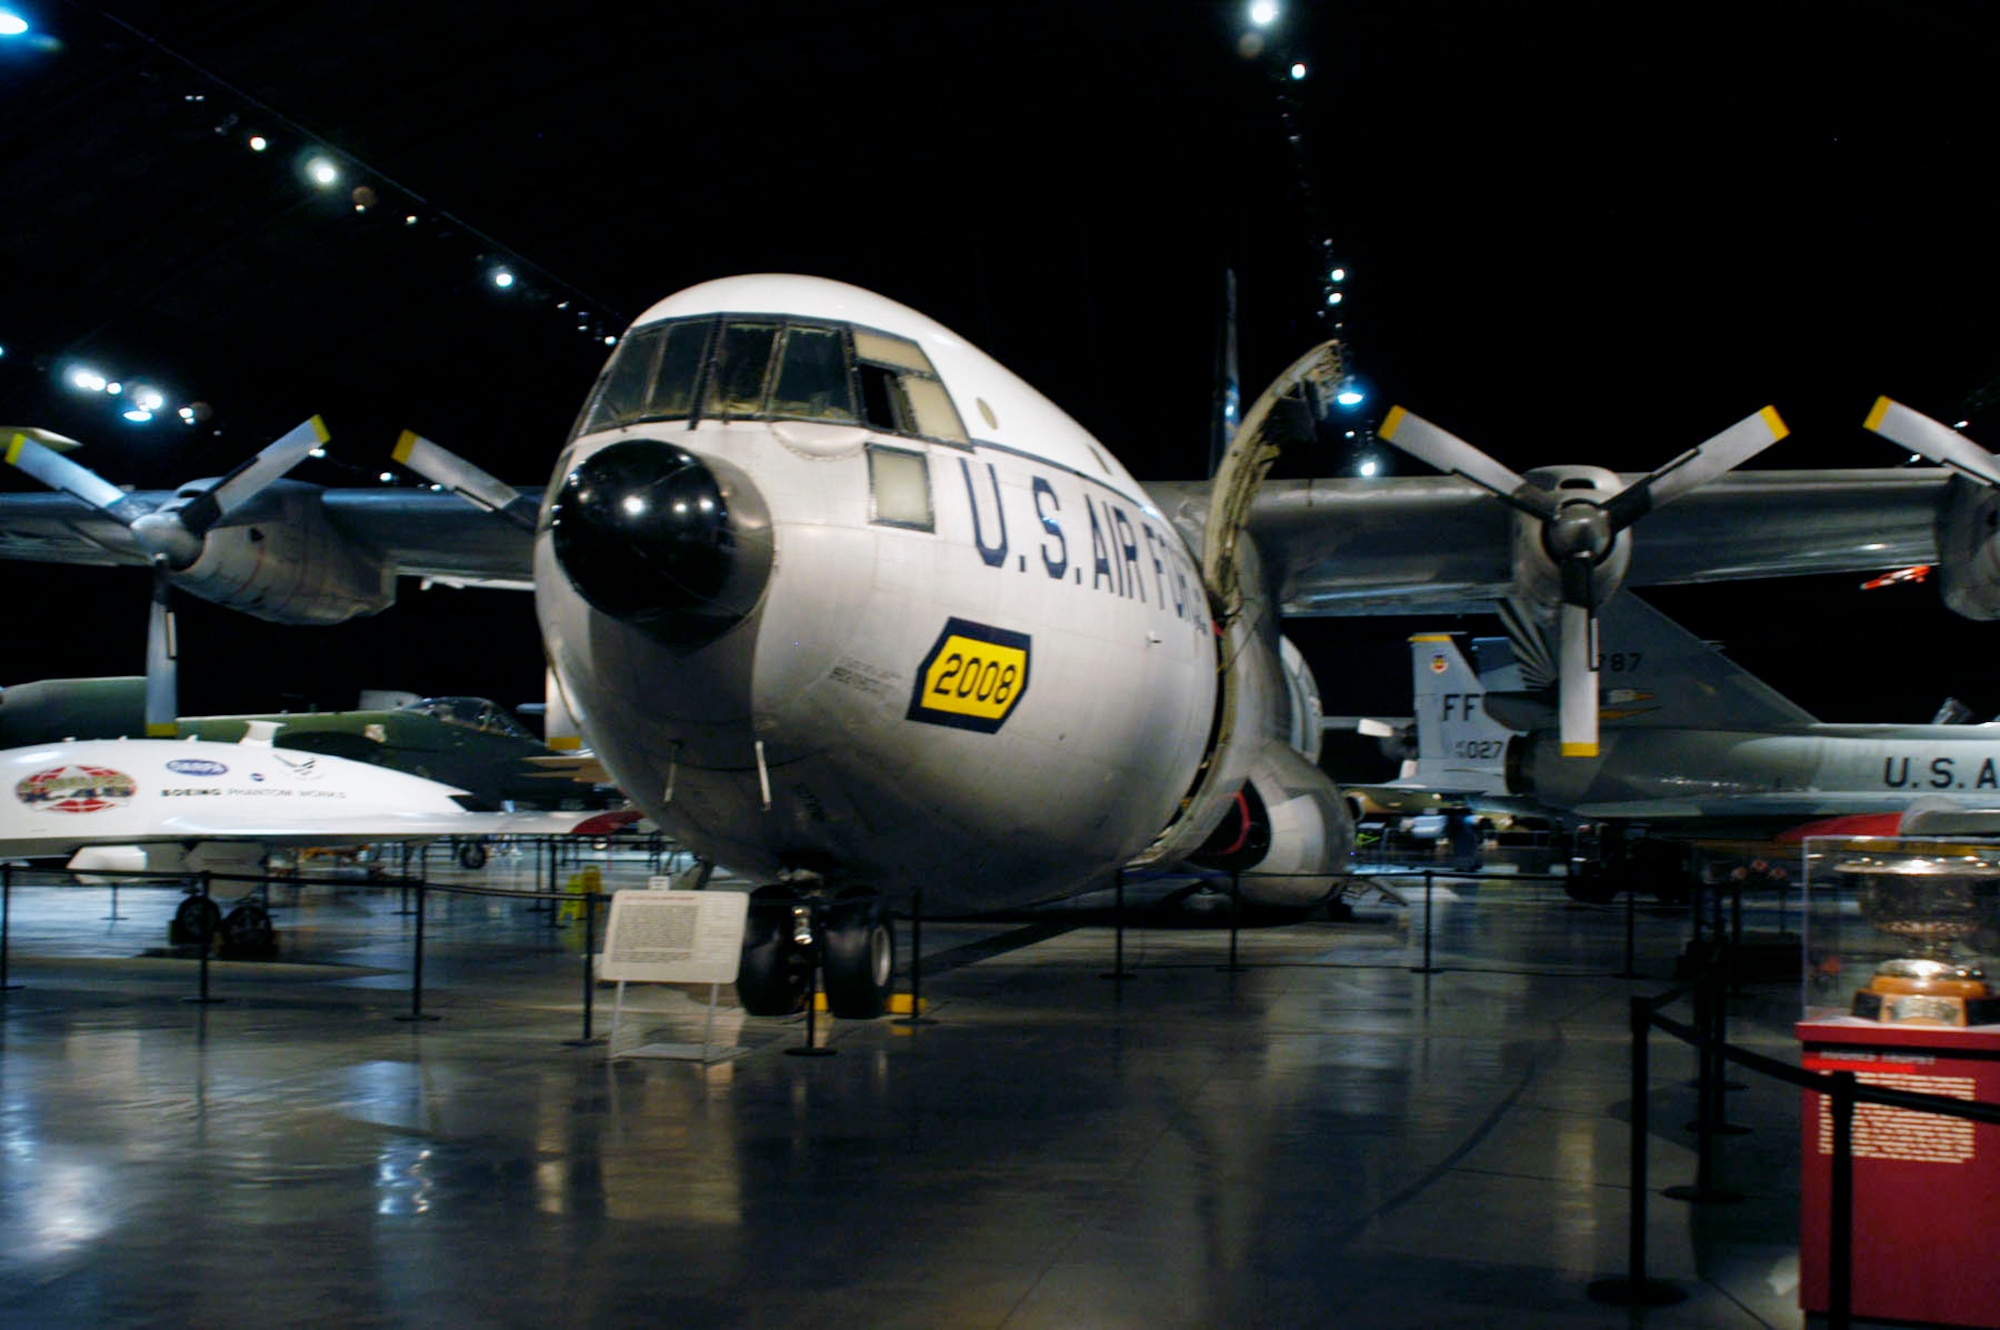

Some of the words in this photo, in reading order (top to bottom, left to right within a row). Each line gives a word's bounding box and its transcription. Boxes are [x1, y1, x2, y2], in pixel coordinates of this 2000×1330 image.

[934, 652, 1017, 704] 2008
[1442, 693, 1481, 721] FF
[161, 788, 222, 797] BOEING
[227, 788, 294, 797] PHANTOM
[299, 790, 348, 799] WORKS
